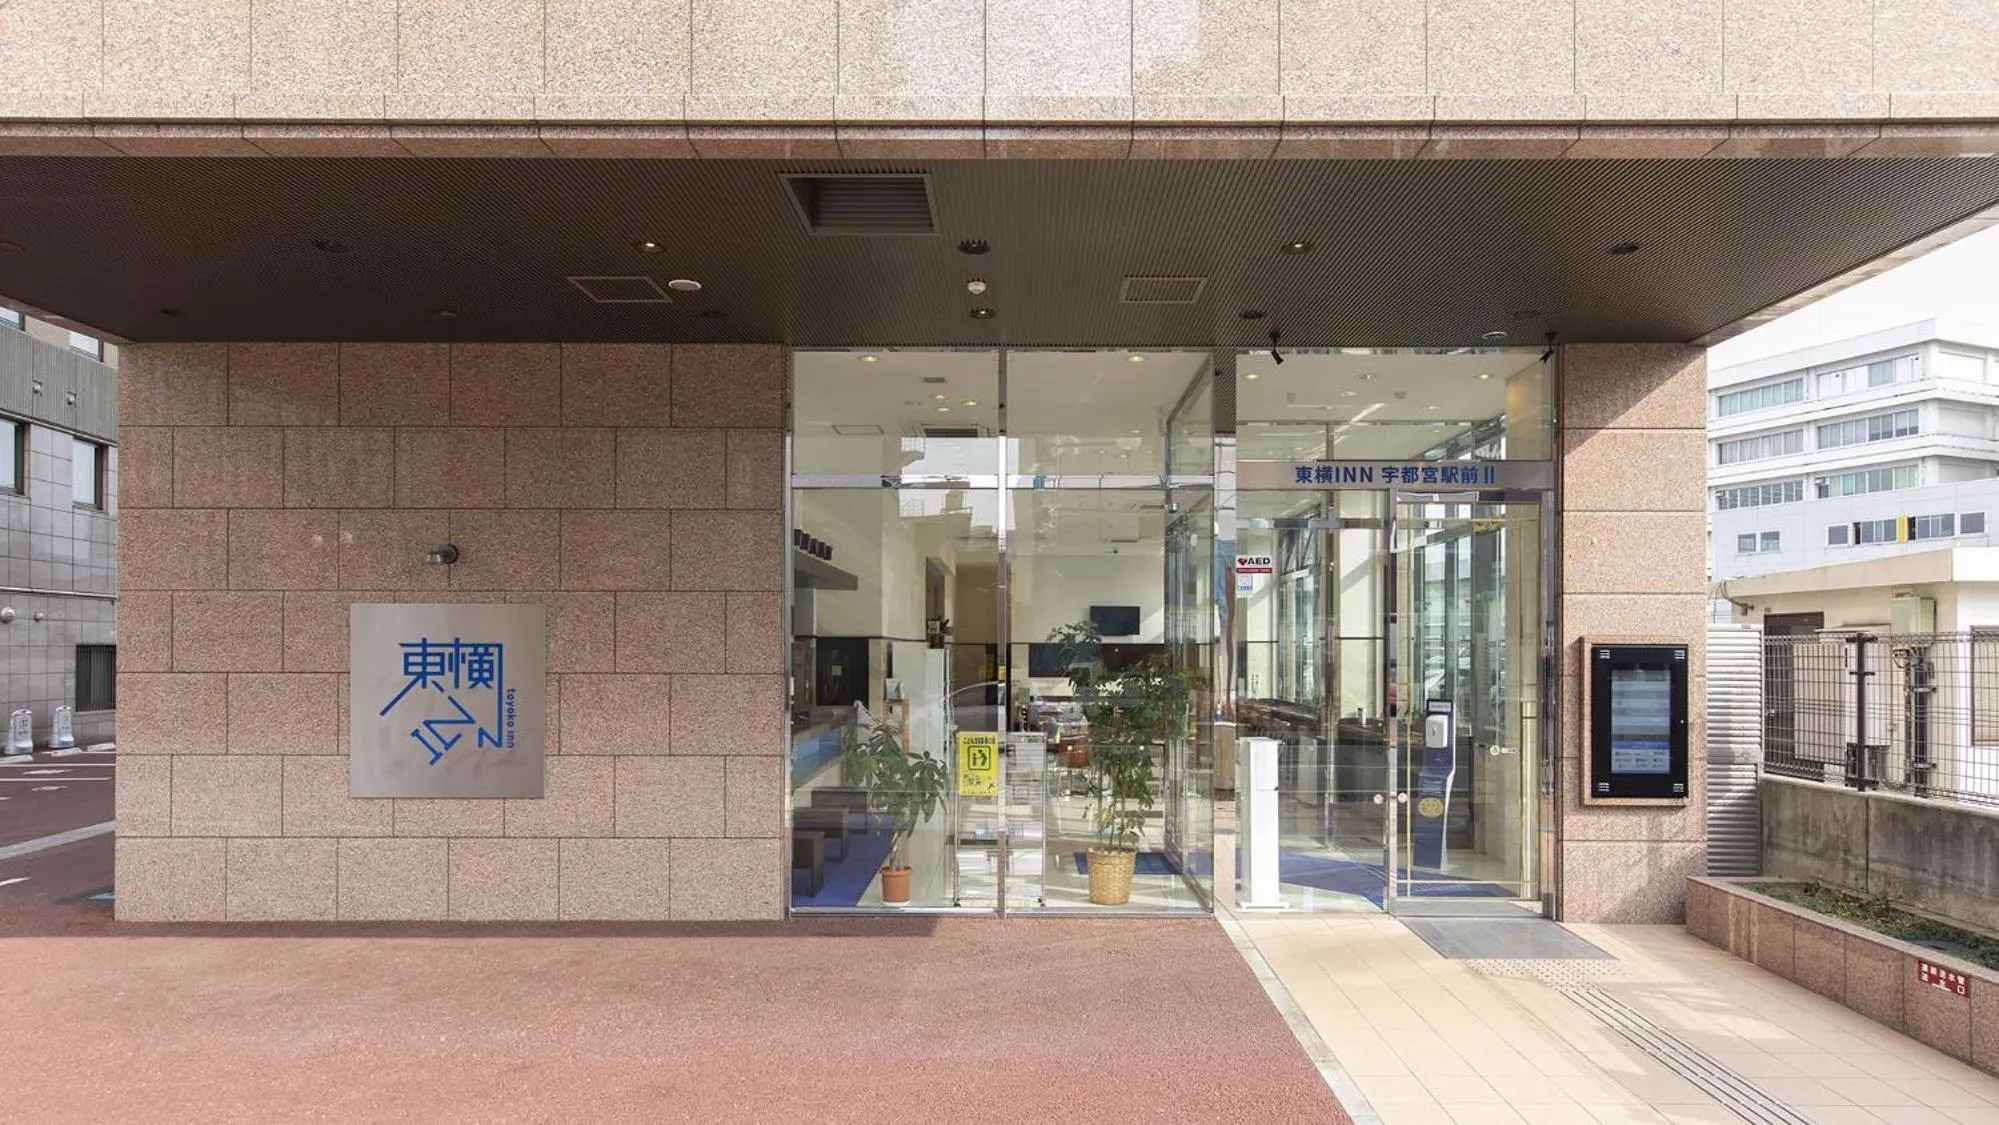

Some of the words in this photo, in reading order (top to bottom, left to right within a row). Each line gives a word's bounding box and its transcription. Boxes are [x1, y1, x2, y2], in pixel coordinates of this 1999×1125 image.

[1295, 466, 1373, 484] 東横INN
[1248, 557, 1271, 565] AED
[506, 688, 517, 727] toyoko
[507, 731, 515, 748] inn
